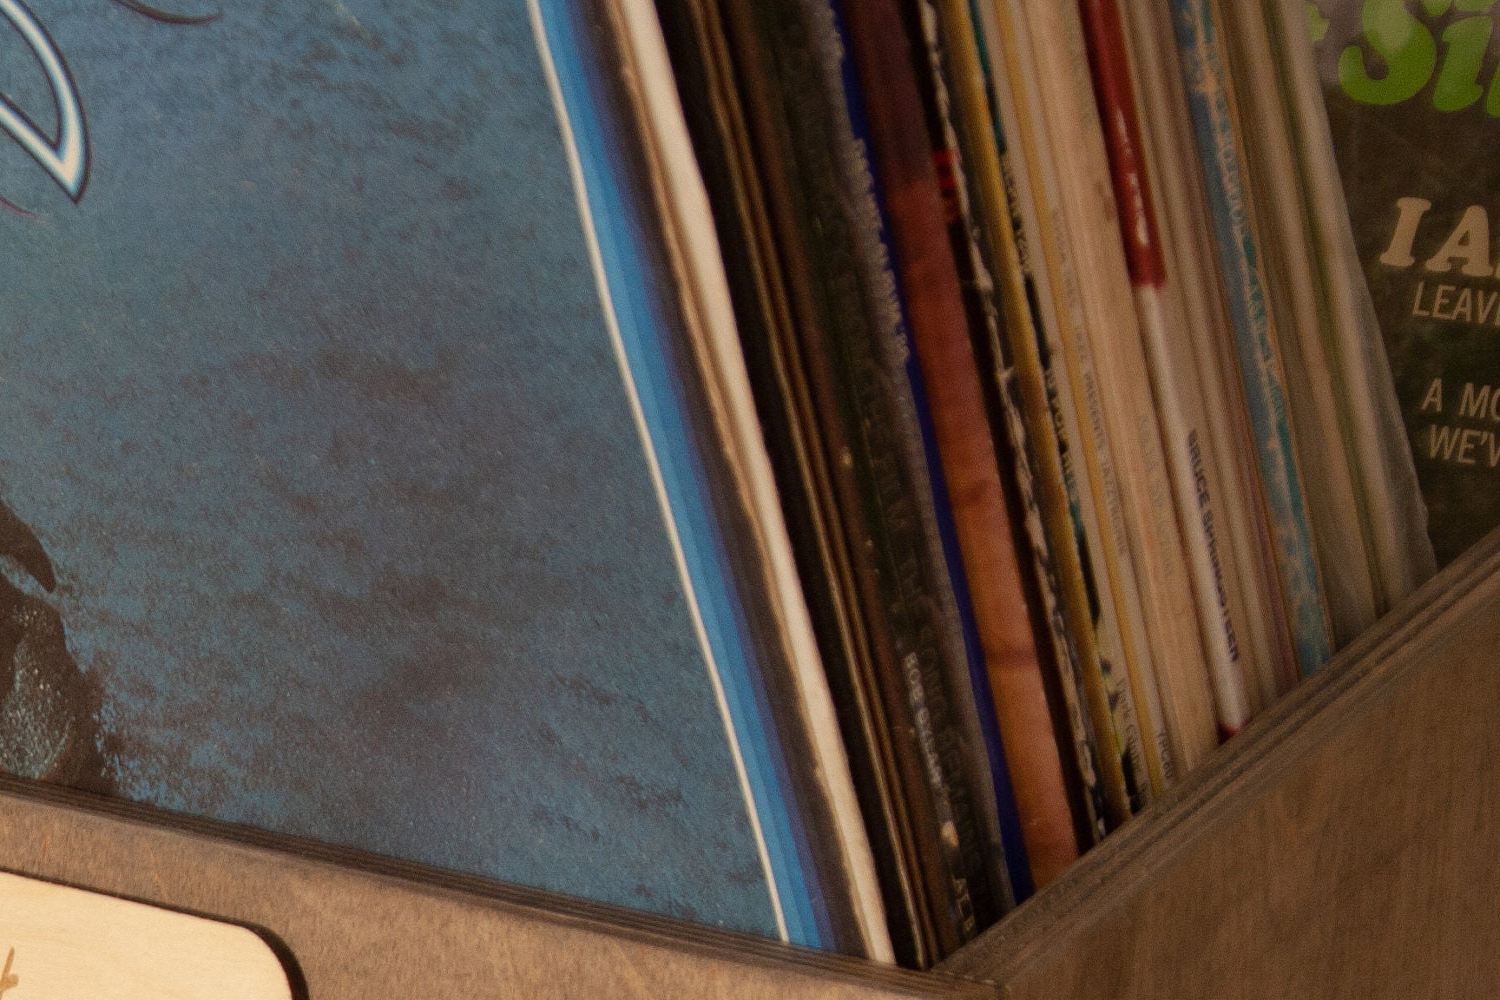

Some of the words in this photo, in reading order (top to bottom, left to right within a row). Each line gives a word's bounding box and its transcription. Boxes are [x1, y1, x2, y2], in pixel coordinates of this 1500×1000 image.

[1380, 197, 1432, 267] I
[1425, 205, 1500, 279] A
[1412, 281, 1500, 326] LEAV
[1420, 377, 1443, 413] A
[1187, 430, 1210, 507] BRUCE
